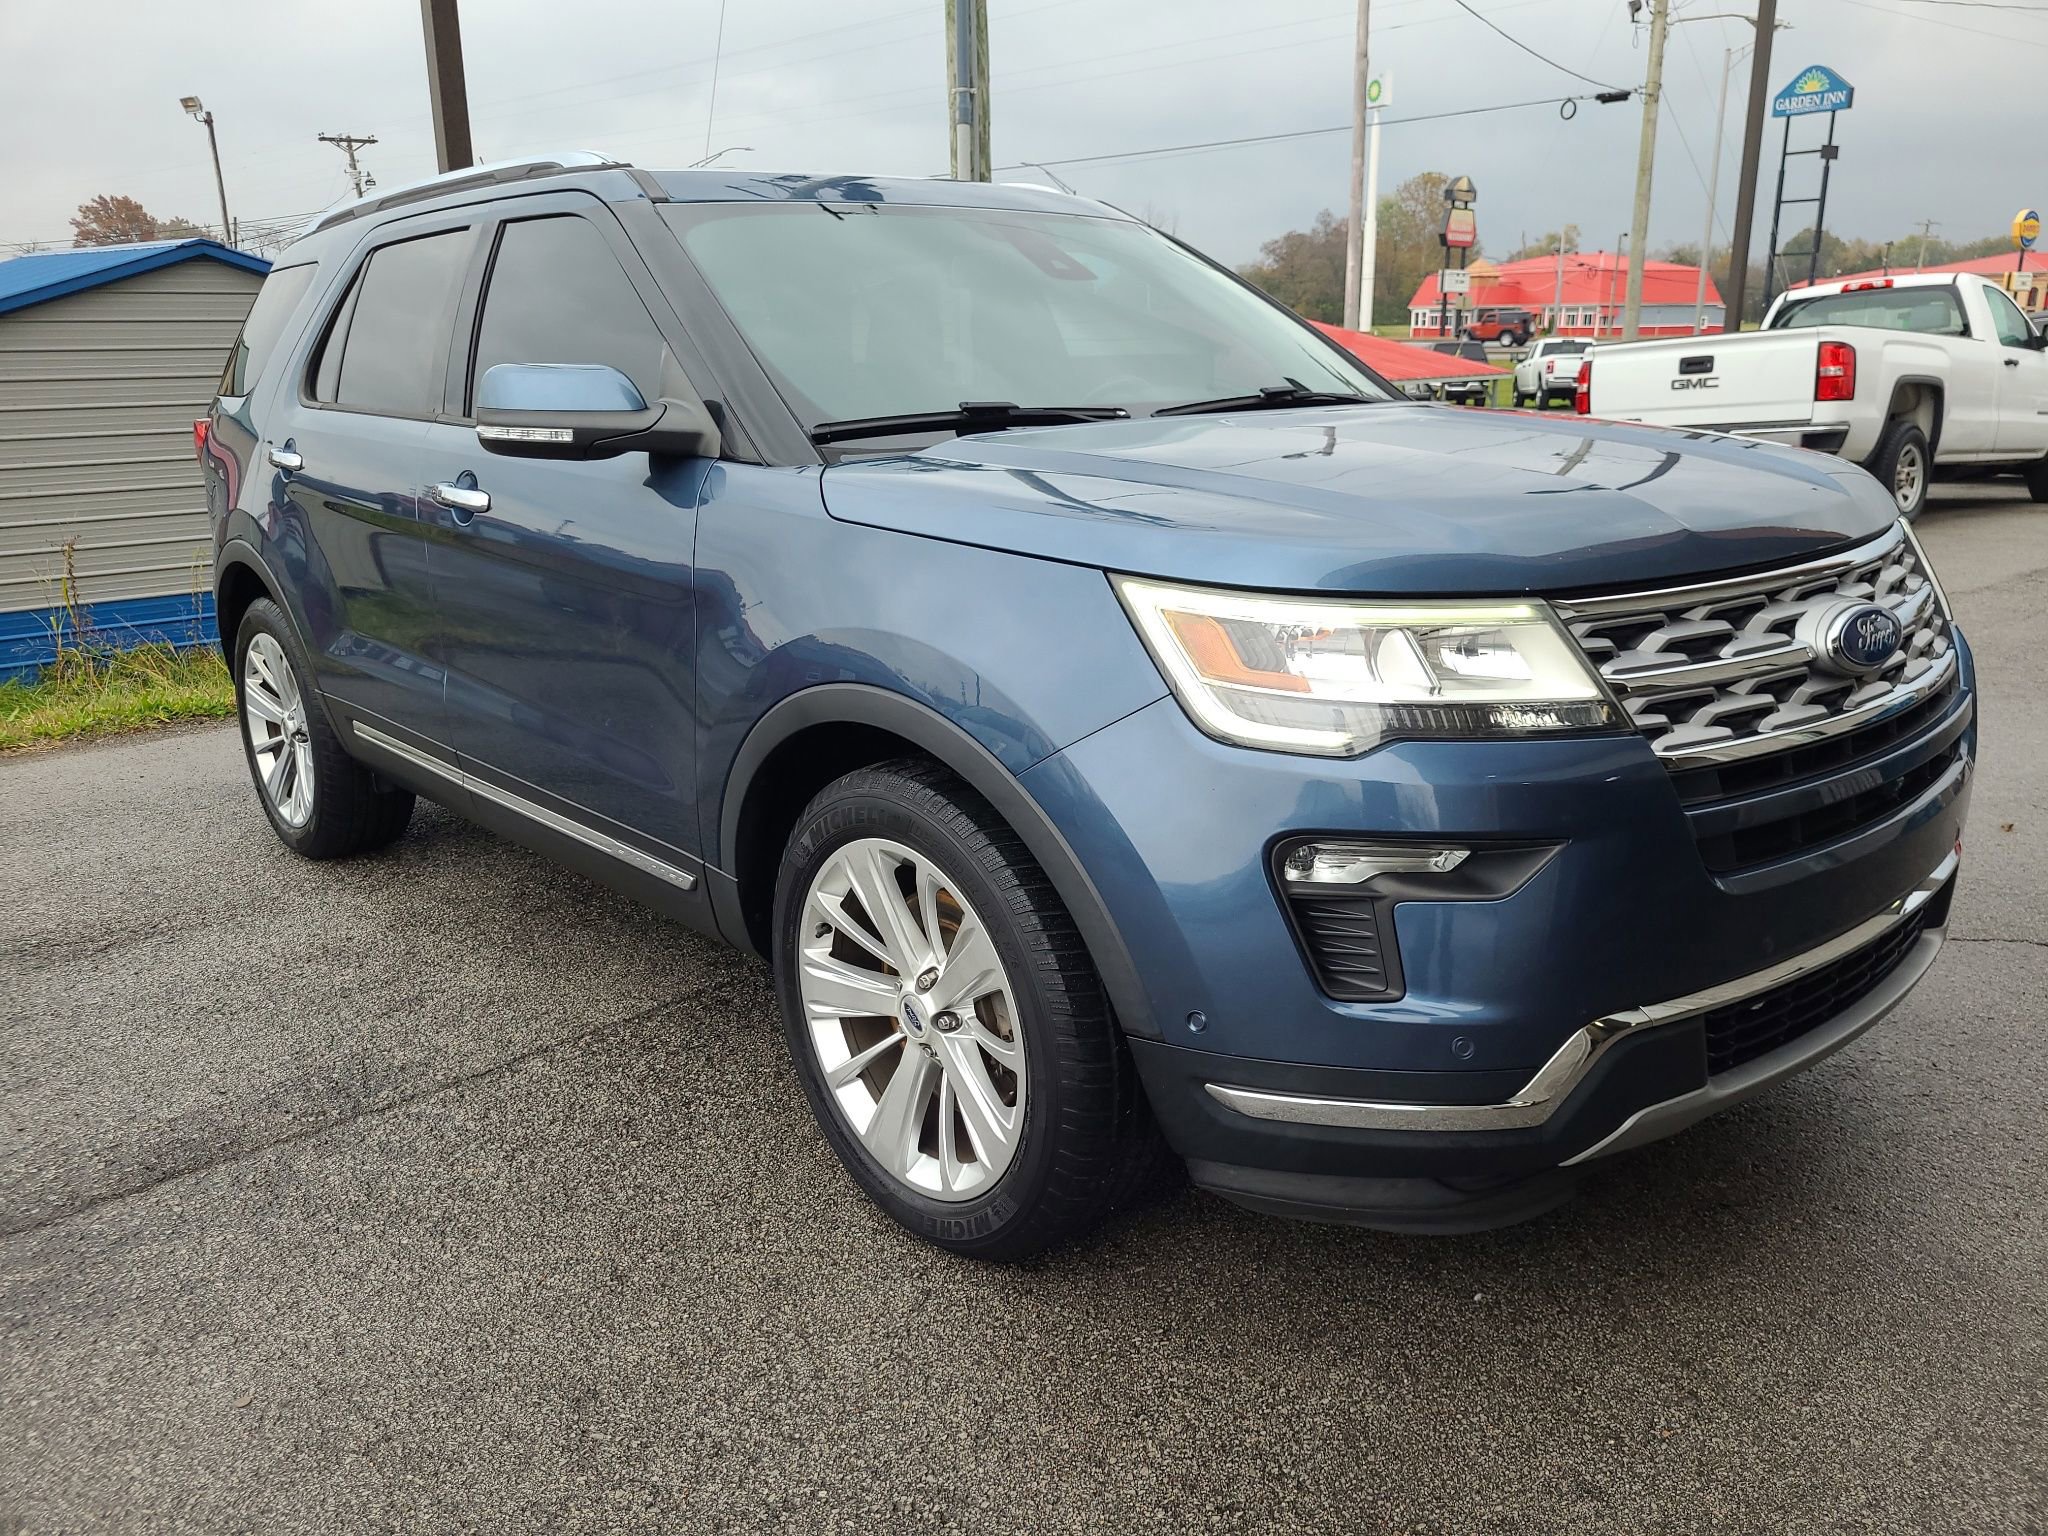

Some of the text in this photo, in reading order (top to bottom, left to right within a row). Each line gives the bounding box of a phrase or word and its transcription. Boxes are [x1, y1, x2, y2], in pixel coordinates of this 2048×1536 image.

[1775, 94, 1821, 111] GARDEN
[1823, 90, 1846, 106] INN
[1671, 377, 1720, 391] GMC
[1856, 614, 1897, 652] Ford
